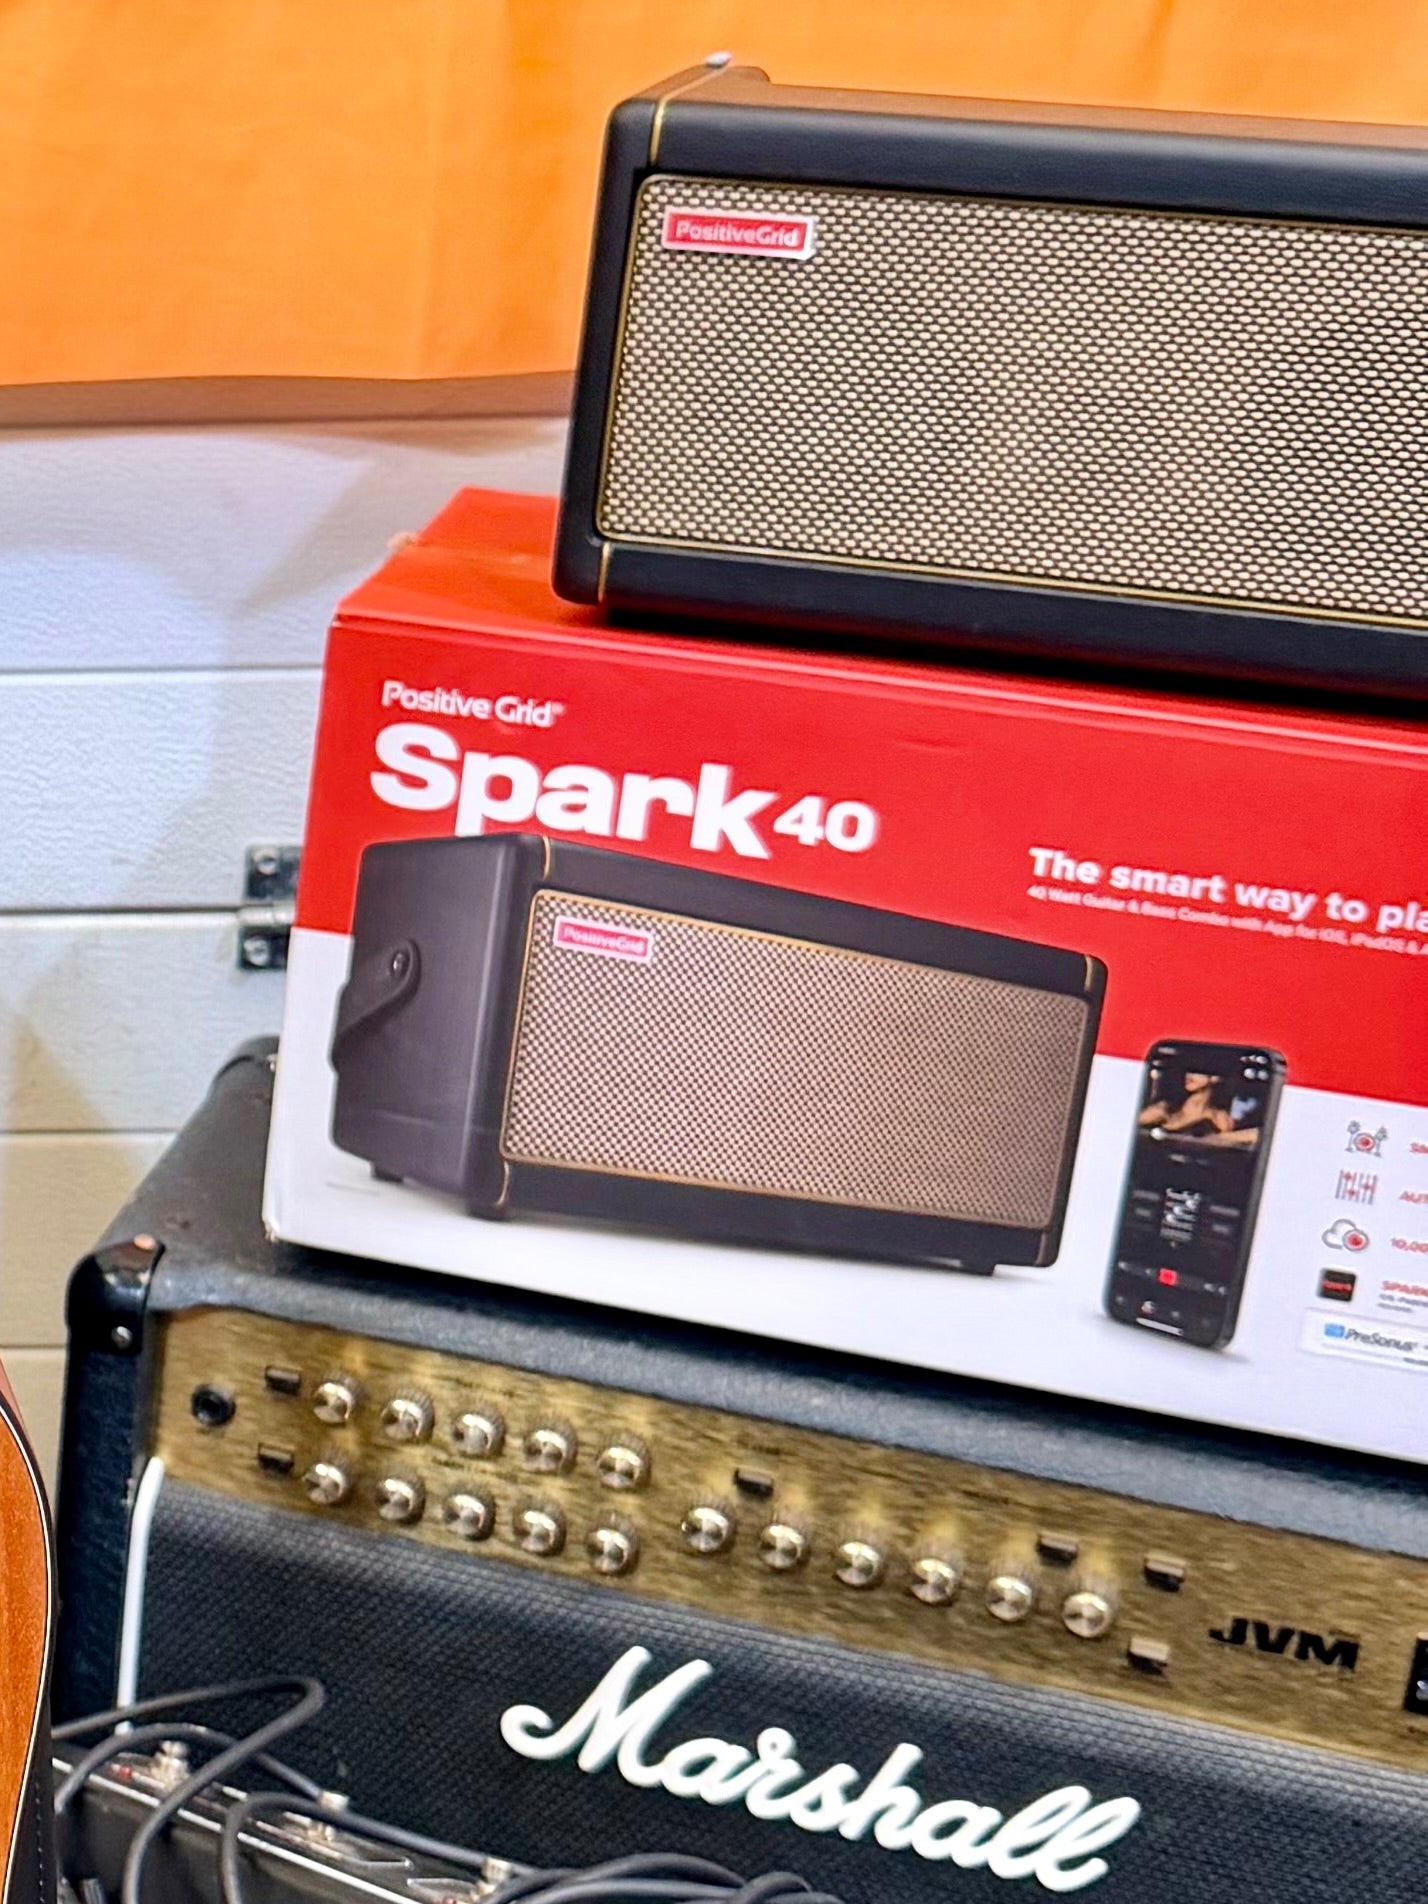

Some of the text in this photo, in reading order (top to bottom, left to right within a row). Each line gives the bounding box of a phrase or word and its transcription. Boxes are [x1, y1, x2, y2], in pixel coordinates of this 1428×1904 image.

[675, 220, 799, 247] PositiveGrid
[382, 680, 491, 720] Positive
[370, 722, 876, 860] Spark 40
[1028, 847, 1099, 884] The
[1109, 864, 1226, 903] smart
[1234, 882, 1316, 920] way
[1325, 893, 1367, 923] to
[1048, 887, 1082, 905] Watt
[1082, 892, 1126, 912] Guitar
[1208, 1617, 1360, 1670] JVM
[500, 1645, 1141, 1892] Marshall
